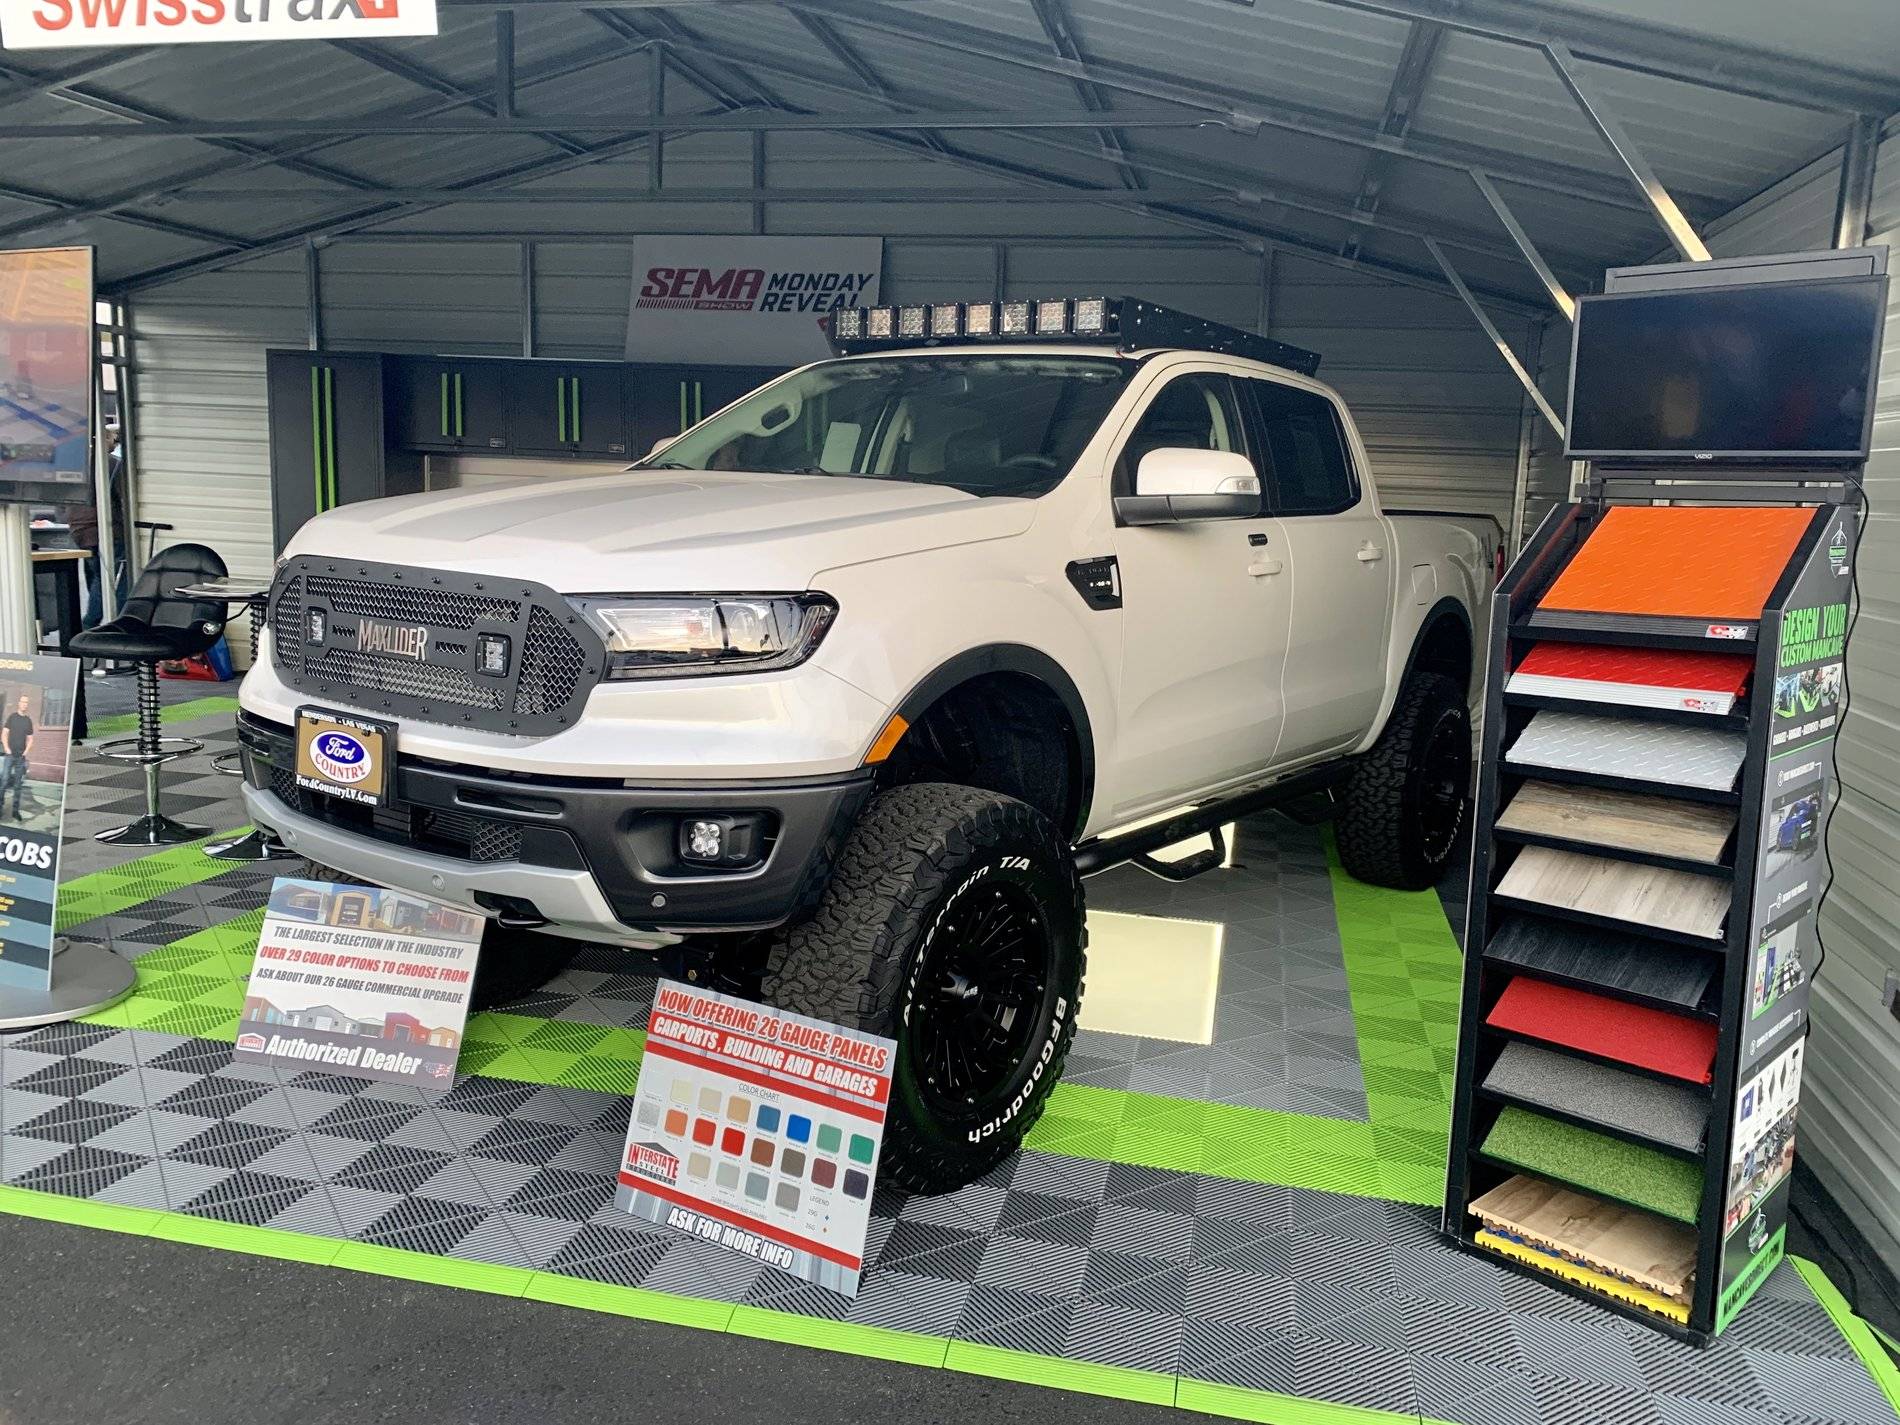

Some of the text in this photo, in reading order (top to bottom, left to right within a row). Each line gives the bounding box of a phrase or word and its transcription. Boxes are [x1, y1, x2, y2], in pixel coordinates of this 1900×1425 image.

[640, 268, 874, 300] SEMA MONDAY
[698, 301, 750, 310] SHOW
[358, 619, 427, 661] MAXLIDER
[1781, 603, 1847, 646] DESIGN YOUR
[1780, 635, 1844, 668] CUSTOM MANCAVE
[325, 736, 356, 760] Ford
[315, 753, 366, 779] COUNTRY
[296, 774, 377, 805] FordCountryLV.Com
[999, 856, 1031, 871] T/A
[274, 926, 464, 960] THE LARGEST SELECTION IN THE INDUSTRY
[260, 945, 470, 983] OVER 29 COLOR OPTIONS TO CHOOSE FROM
[256, 967, 464, 1004] ASK ABOUT OUR 26 GAUGE COMMERCIAL UPGRADE
[657, 988, 888, 1070] NOW OFFERING 26 GAUGE PANELS
[264, 1035, 362, 1067] Authorized
[360, 1047, 423, 1075] Dealer
[723, 1036, 785, 1070] BUILDING
[783, 1054, 814, 1077] AND
[813, 1062, 878, 1097] GARAGES
[968, 996, 1067, 1144] BFGoodrich
[739, 1083, 780, 1100] COLOR CHART
[627, 1143, 680, 1179] INTERSTATE
[639, 1161, 665, 1174] STEEL
[809, 1195, 830, 1207] LEGEND
[666, 1206, 698, 1232] ASK
[695, 1215, 724, 1243] FOR
[721, 1225, 762, 1257] MORE
[759, 1240, 794, 1269] INFO
